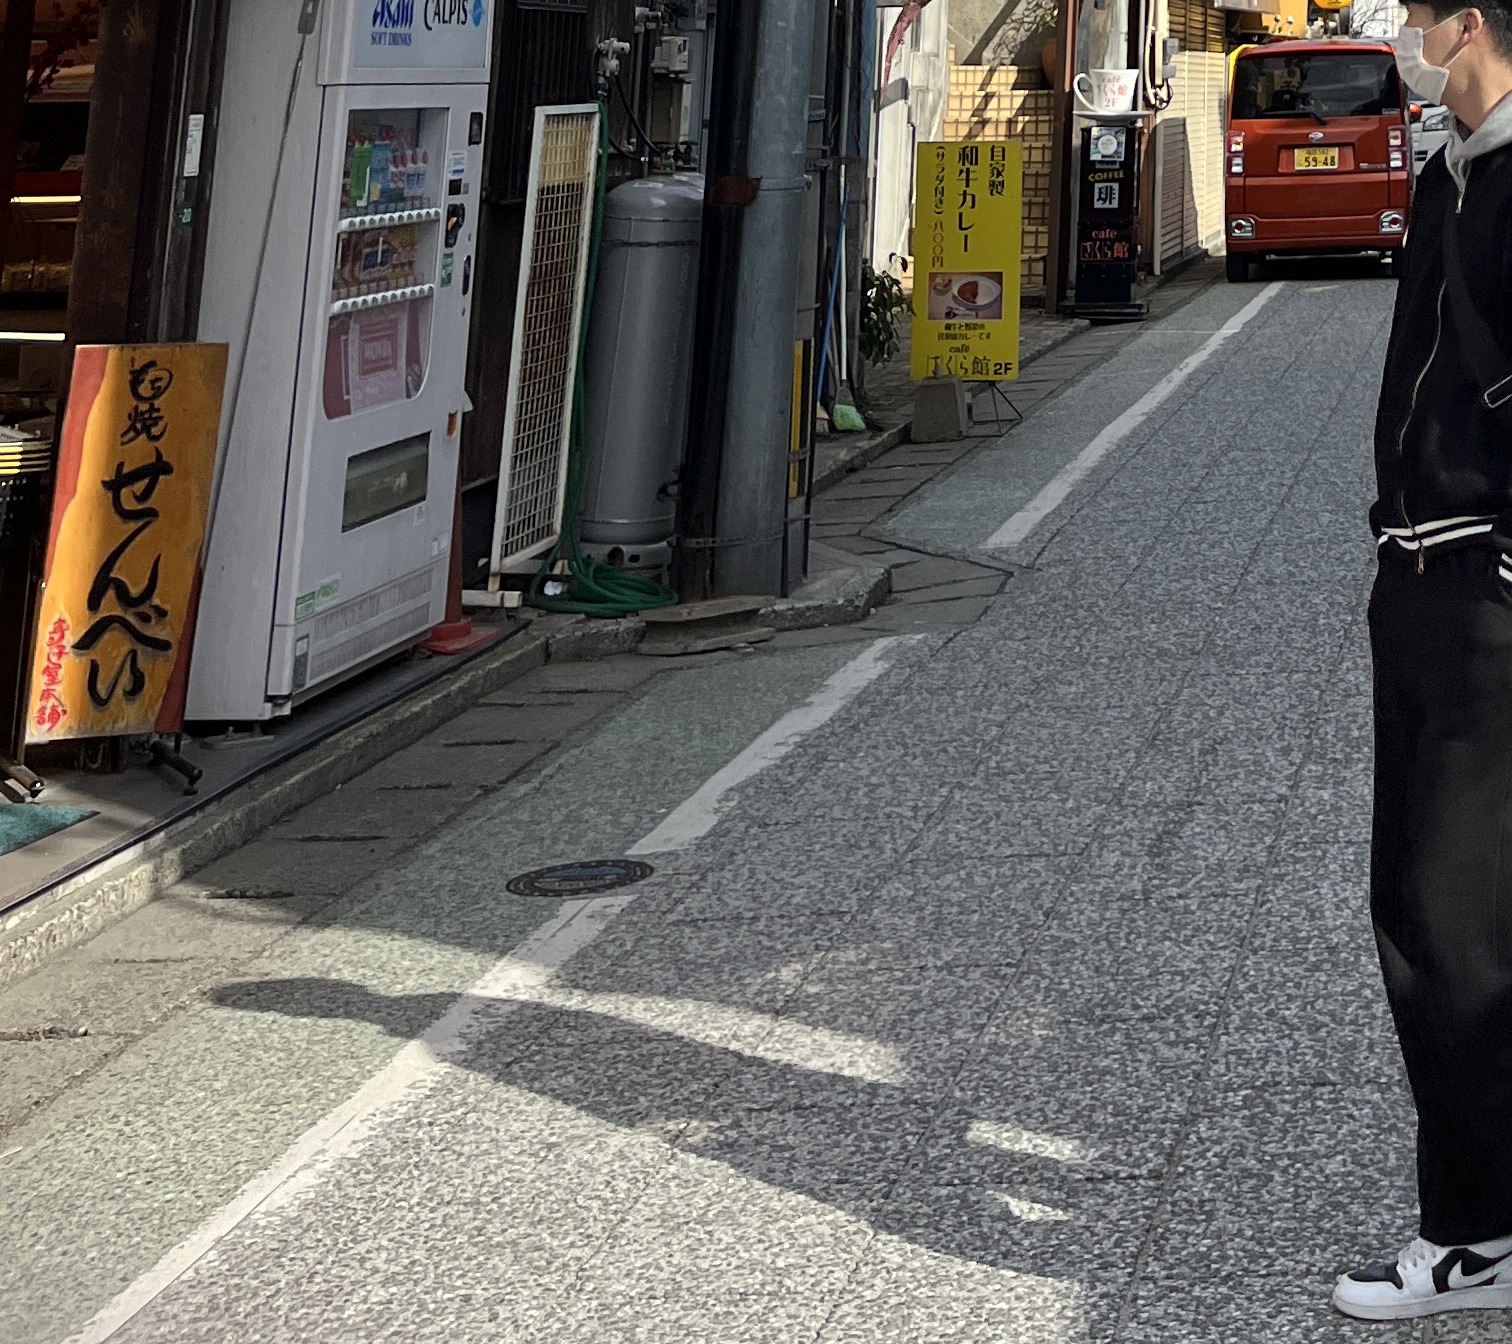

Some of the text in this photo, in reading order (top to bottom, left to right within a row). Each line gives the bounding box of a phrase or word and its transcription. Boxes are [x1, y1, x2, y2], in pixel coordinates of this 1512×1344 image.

[988, 144, 1006, 196] 自家製
[1088, 169, 1125, 182] COFFEE
[957, 145, 978, 253] 和牛カレー
[993, 362, 1013, 376] 2F
